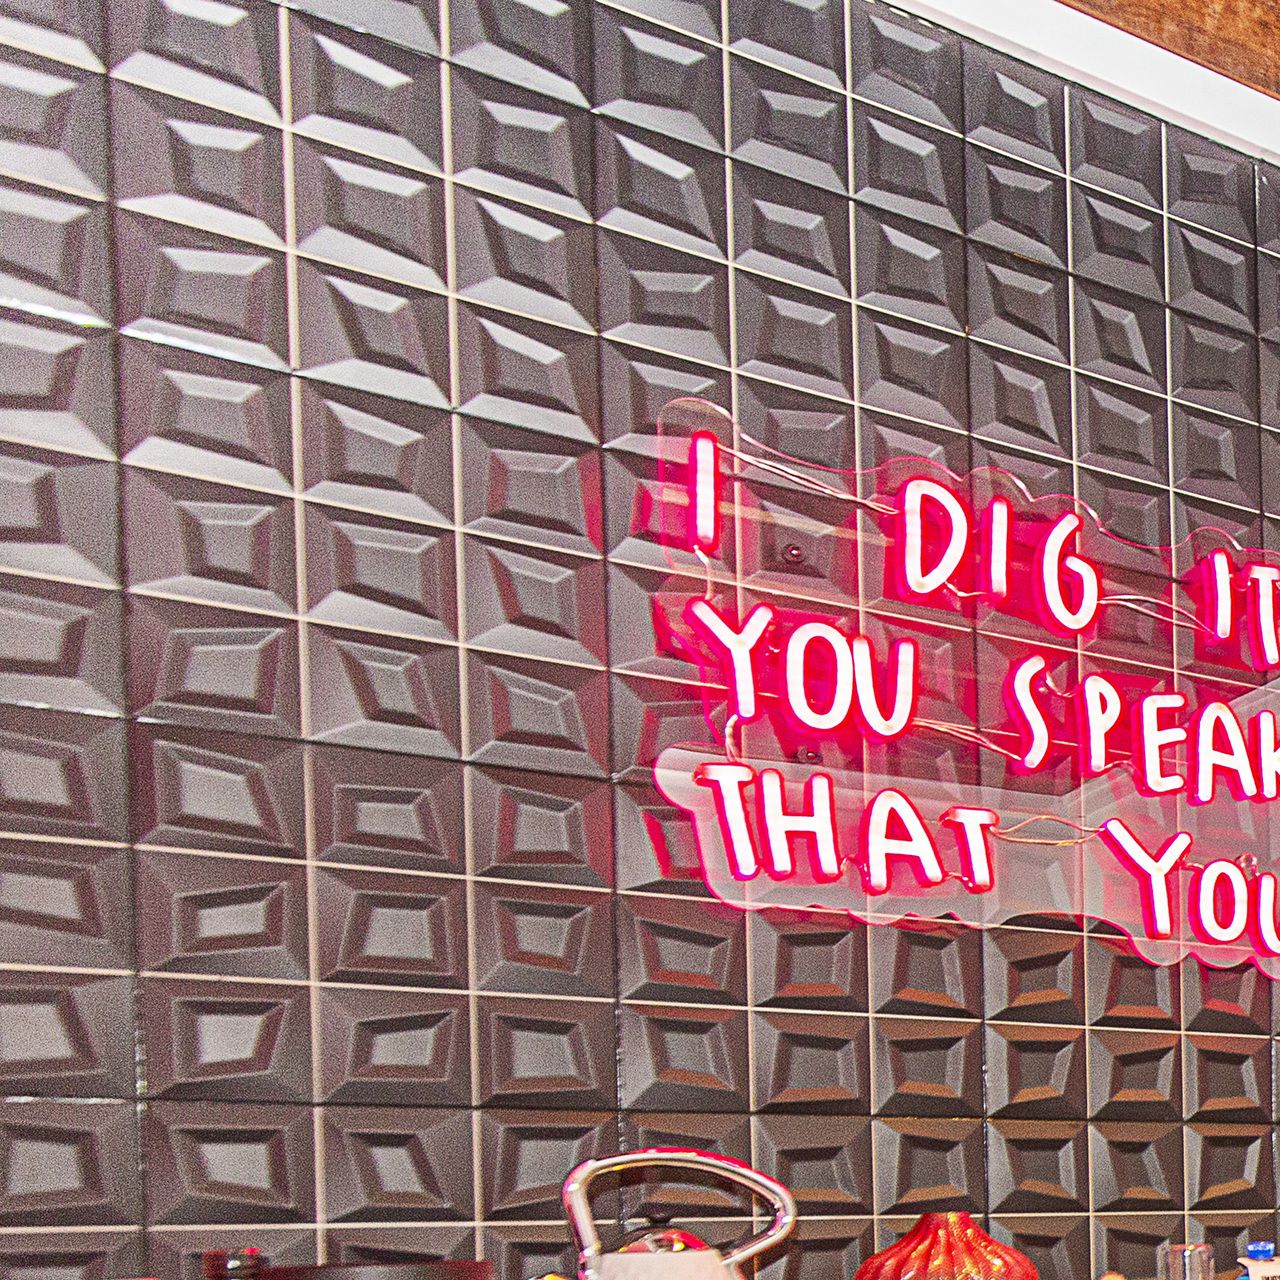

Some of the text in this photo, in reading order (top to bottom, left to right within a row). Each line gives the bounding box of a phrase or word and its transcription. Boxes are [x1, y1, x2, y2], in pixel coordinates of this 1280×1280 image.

[692, 431, 718, 550] I
[900, 478, 1100, 634] DIG
[689, 599, 917, 739] YOU
[694, 763, 998, 892] THAT
